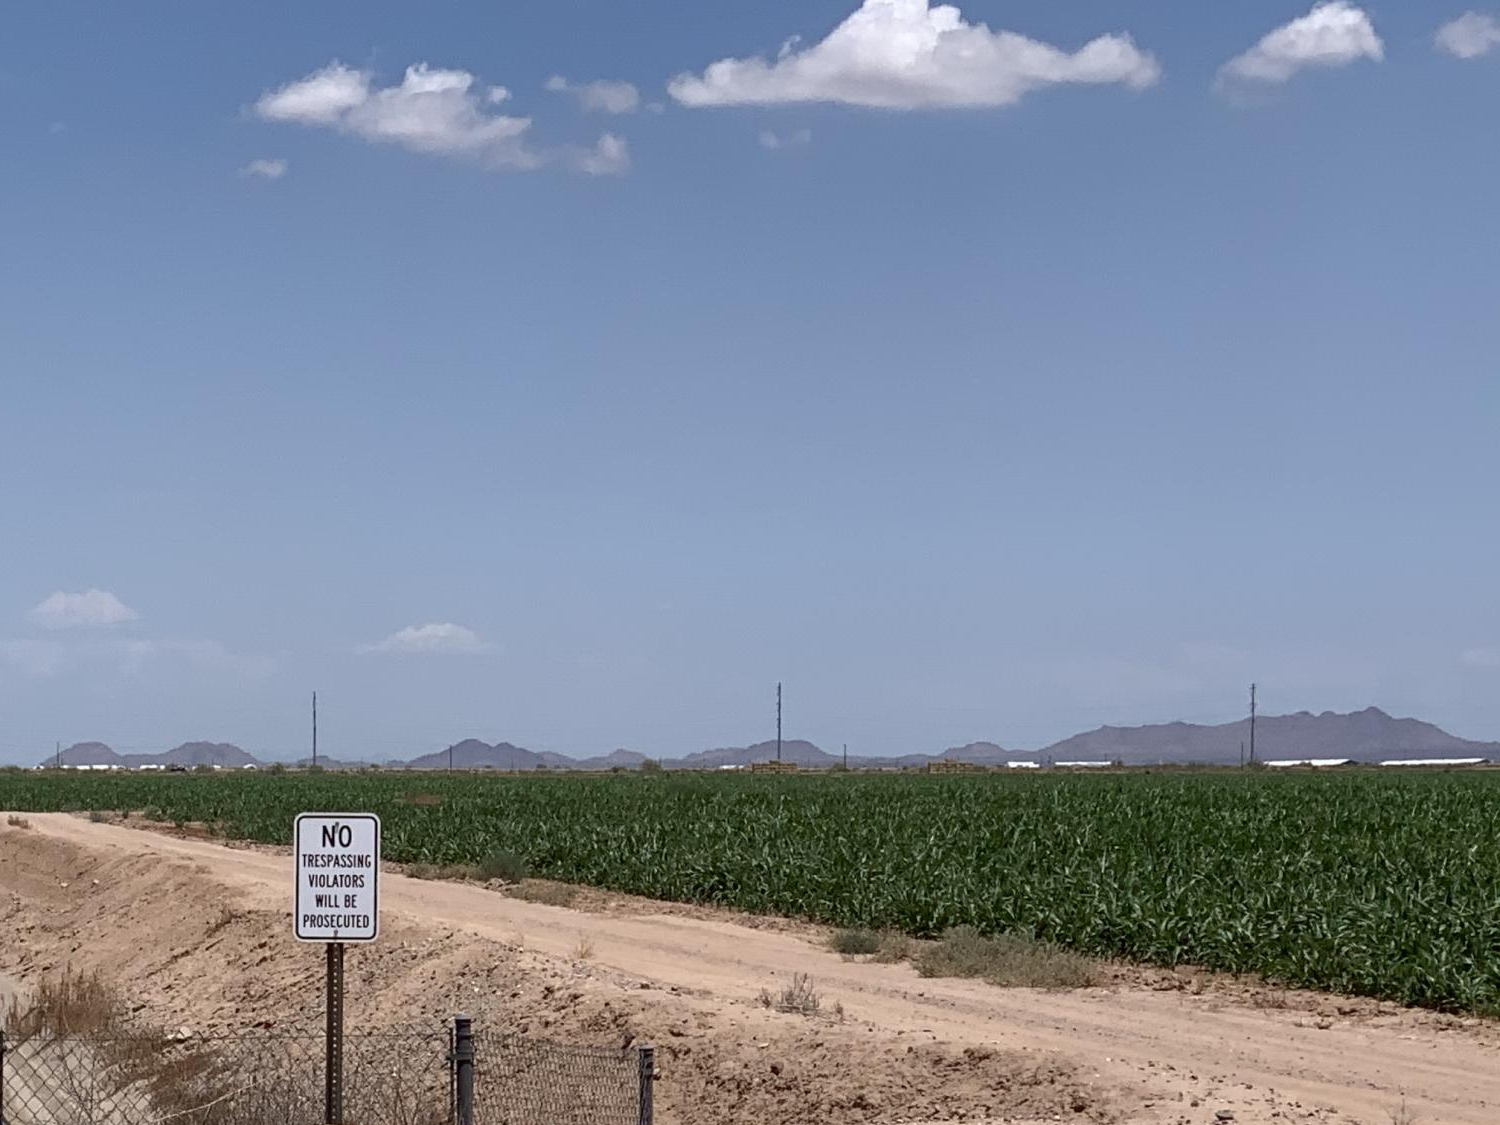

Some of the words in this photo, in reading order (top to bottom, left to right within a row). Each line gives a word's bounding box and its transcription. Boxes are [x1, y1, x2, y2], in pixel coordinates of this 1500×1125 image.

[322, 825, 352, 848] NO
[302, 853, 372, 868] TRESPASSING
[308, 874, 365, 888] VIOLATORS
[315, 894, 340, 908] WILL
[344, 894, 357, 908] BE
[303, 914, 370, 929] PROSECUTED
